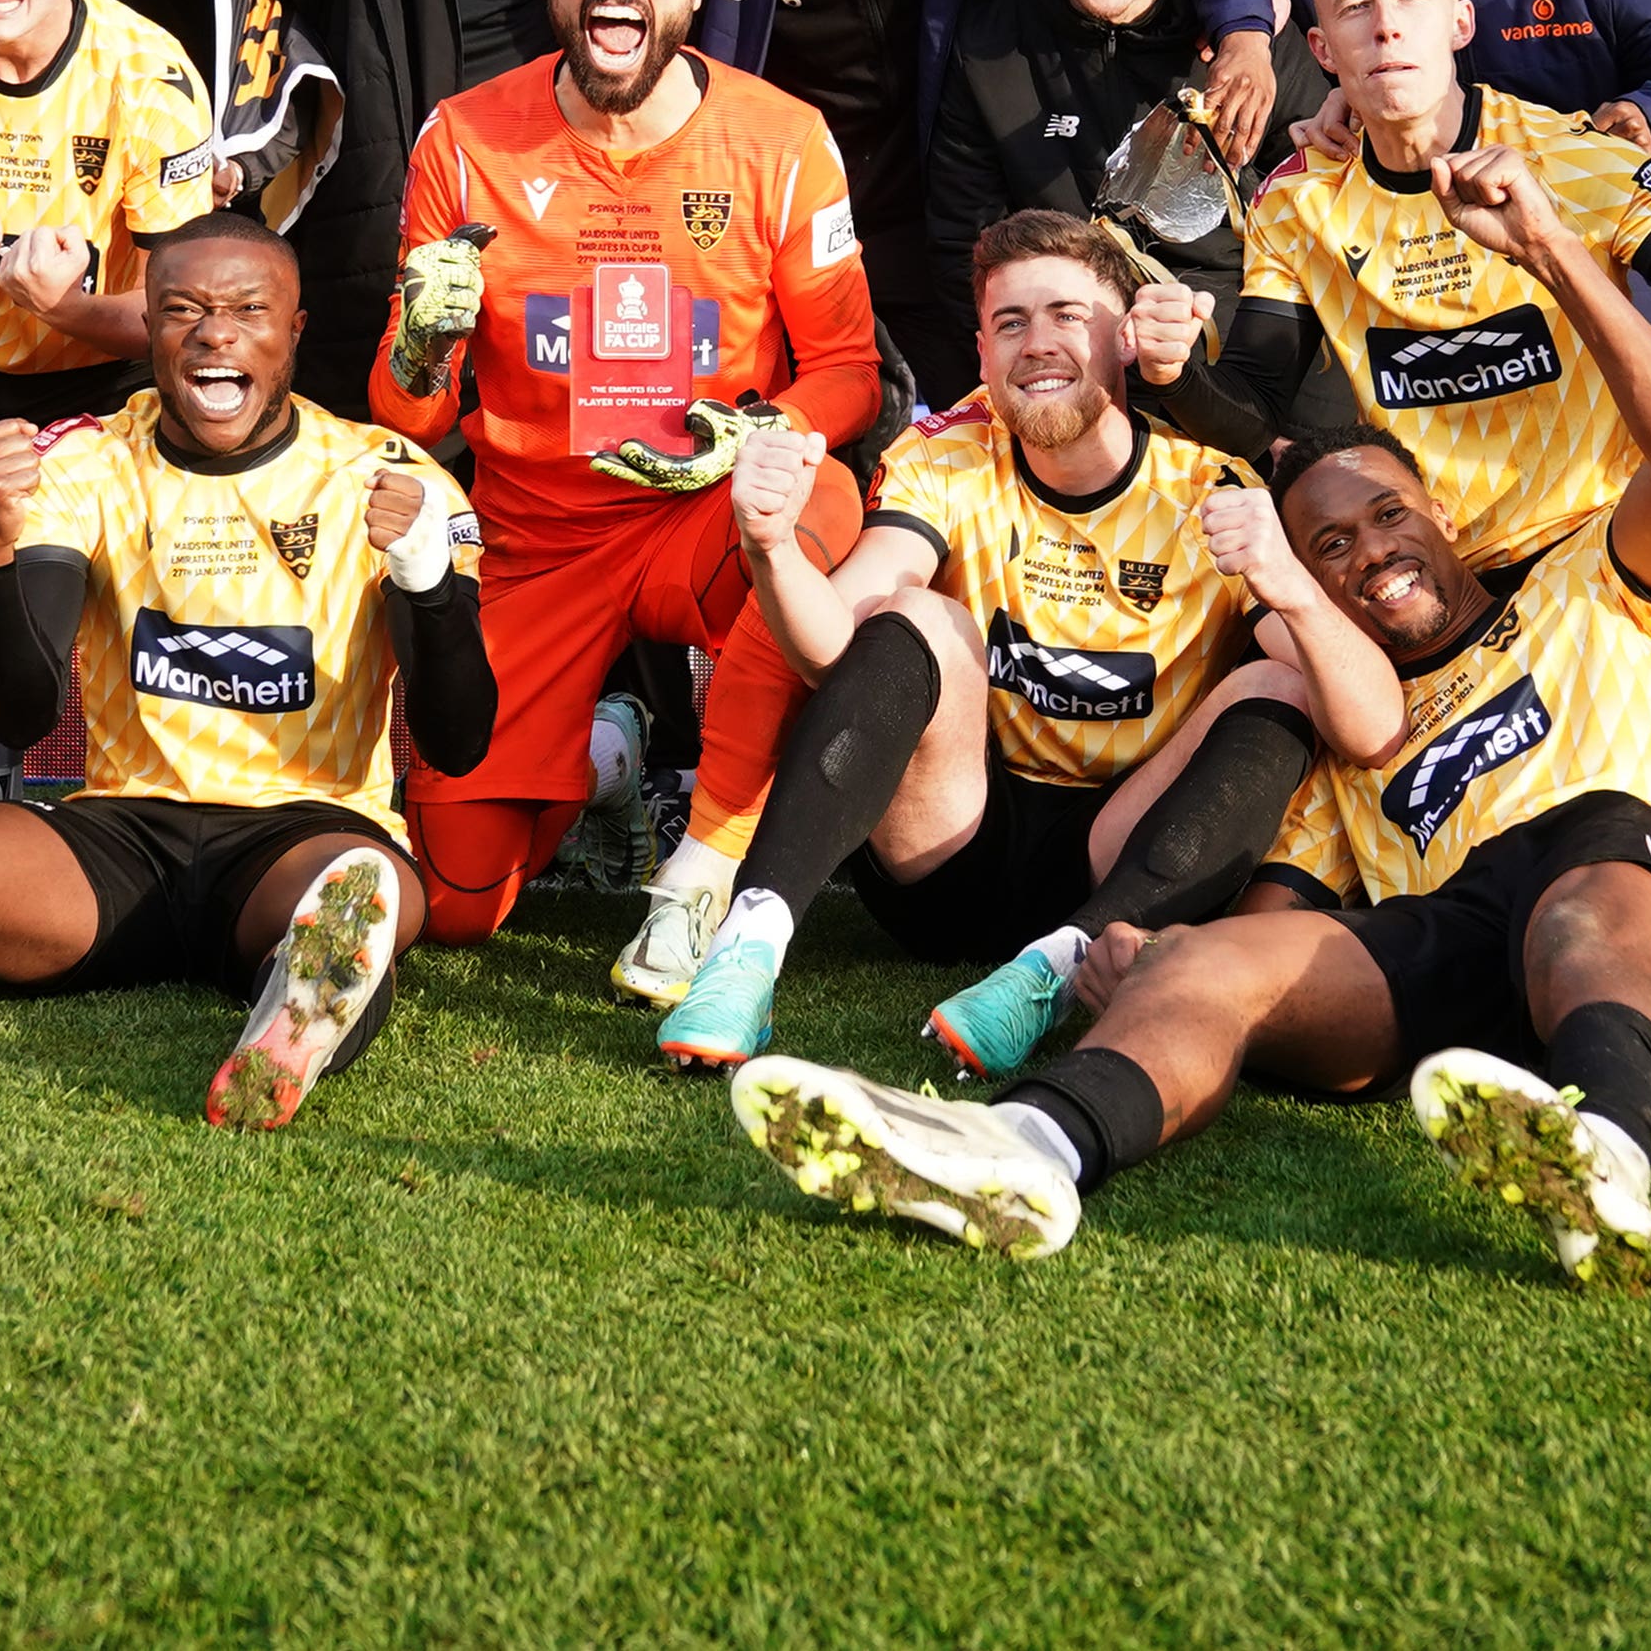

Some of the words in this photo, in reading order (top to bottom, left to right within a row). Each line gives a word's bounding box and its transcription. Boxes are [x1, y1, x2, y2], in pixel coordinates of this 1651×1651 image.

[1501, 20, 1593, 41] vanarama
[20, 134, 43, 142] TOWN
[23, 158, 50, 168] UNITED
[24, 171, 40, 179] CUP
[29, 184, 50, 193] 2024
[689, 194, 725, 202] MUFC
[589, 204, 625, 213] IPSWICH
[627, 205, 651, 213] TOWN
[579, 230, 627, 239] MAIDSTONE
[629, 230, 660, 240] UNITED
[1400, 235, 1434, 248] IPSWICH
[1436, 230, 1456, 241] TOWN
[576, 242, 618, 252] EMIRATES
[620, 244, 630, 252] FA
[632, 244, 650, 252] CUP
[1395, 259, 1439, 273] MAIDSTONE
[1441, 253, 1468, 267] UNITED
[1393, 274, 1432, 288] EMIRATES
[1445, 269, 1460, 279] CUP
[1395, 292, 1413, 301] 27TH
[1416, 284, 1449, 297] JANUARY
[1452, 280, 1471, 291] 2024
[605, 320, 659, 333] Emirates
[605, 335, 625, 347] FA
[626, 334, 660, 347] CUP
[1380, 344, 1553, 402] Manchett
[578, 398, 613, 406] PLAYER
[615, 398, 629, 406] OF
[631, 398, 649, 406] THE
[652, 398, 686, 406] MATCH
[184, 516, 219, 525] IPSWICH
[222, 516, 245, 524] TOWN
[174, 541, 223, 550] MAIDSTONE
[224, 540, 255, 549] UNITED
[1037, 535, 1071, 551] IPSWICH
[1073, 545, 1097, 553] TOWN
[171, 554, 213, 564] EMIRATES
[216, 554, 225, 562] FA
[229, 553, 246, 562] CUP
[172, 568, 192, 577] 27TH
[195, 567, 232, 576] JANUARY
[236, 565, 257, 574] 2024
[1024, 559, 1071, 577] MAIDSTONE
[1074, 570, 1104, 580] UNITED
[1125, 563, 1165, 574] MUFC
[1023, 571, 1060, 587] MIRATES
[1062, 581, 1071, 589] FA
[1074, 583, 1092, 592] CUP
[1040, 590, 1076, 603] JANUARY
[1079, 597, 1101, 606] 2024
[135, 650, 308, 707] Manchett
[990, 643, 1147, 715] Manchett
